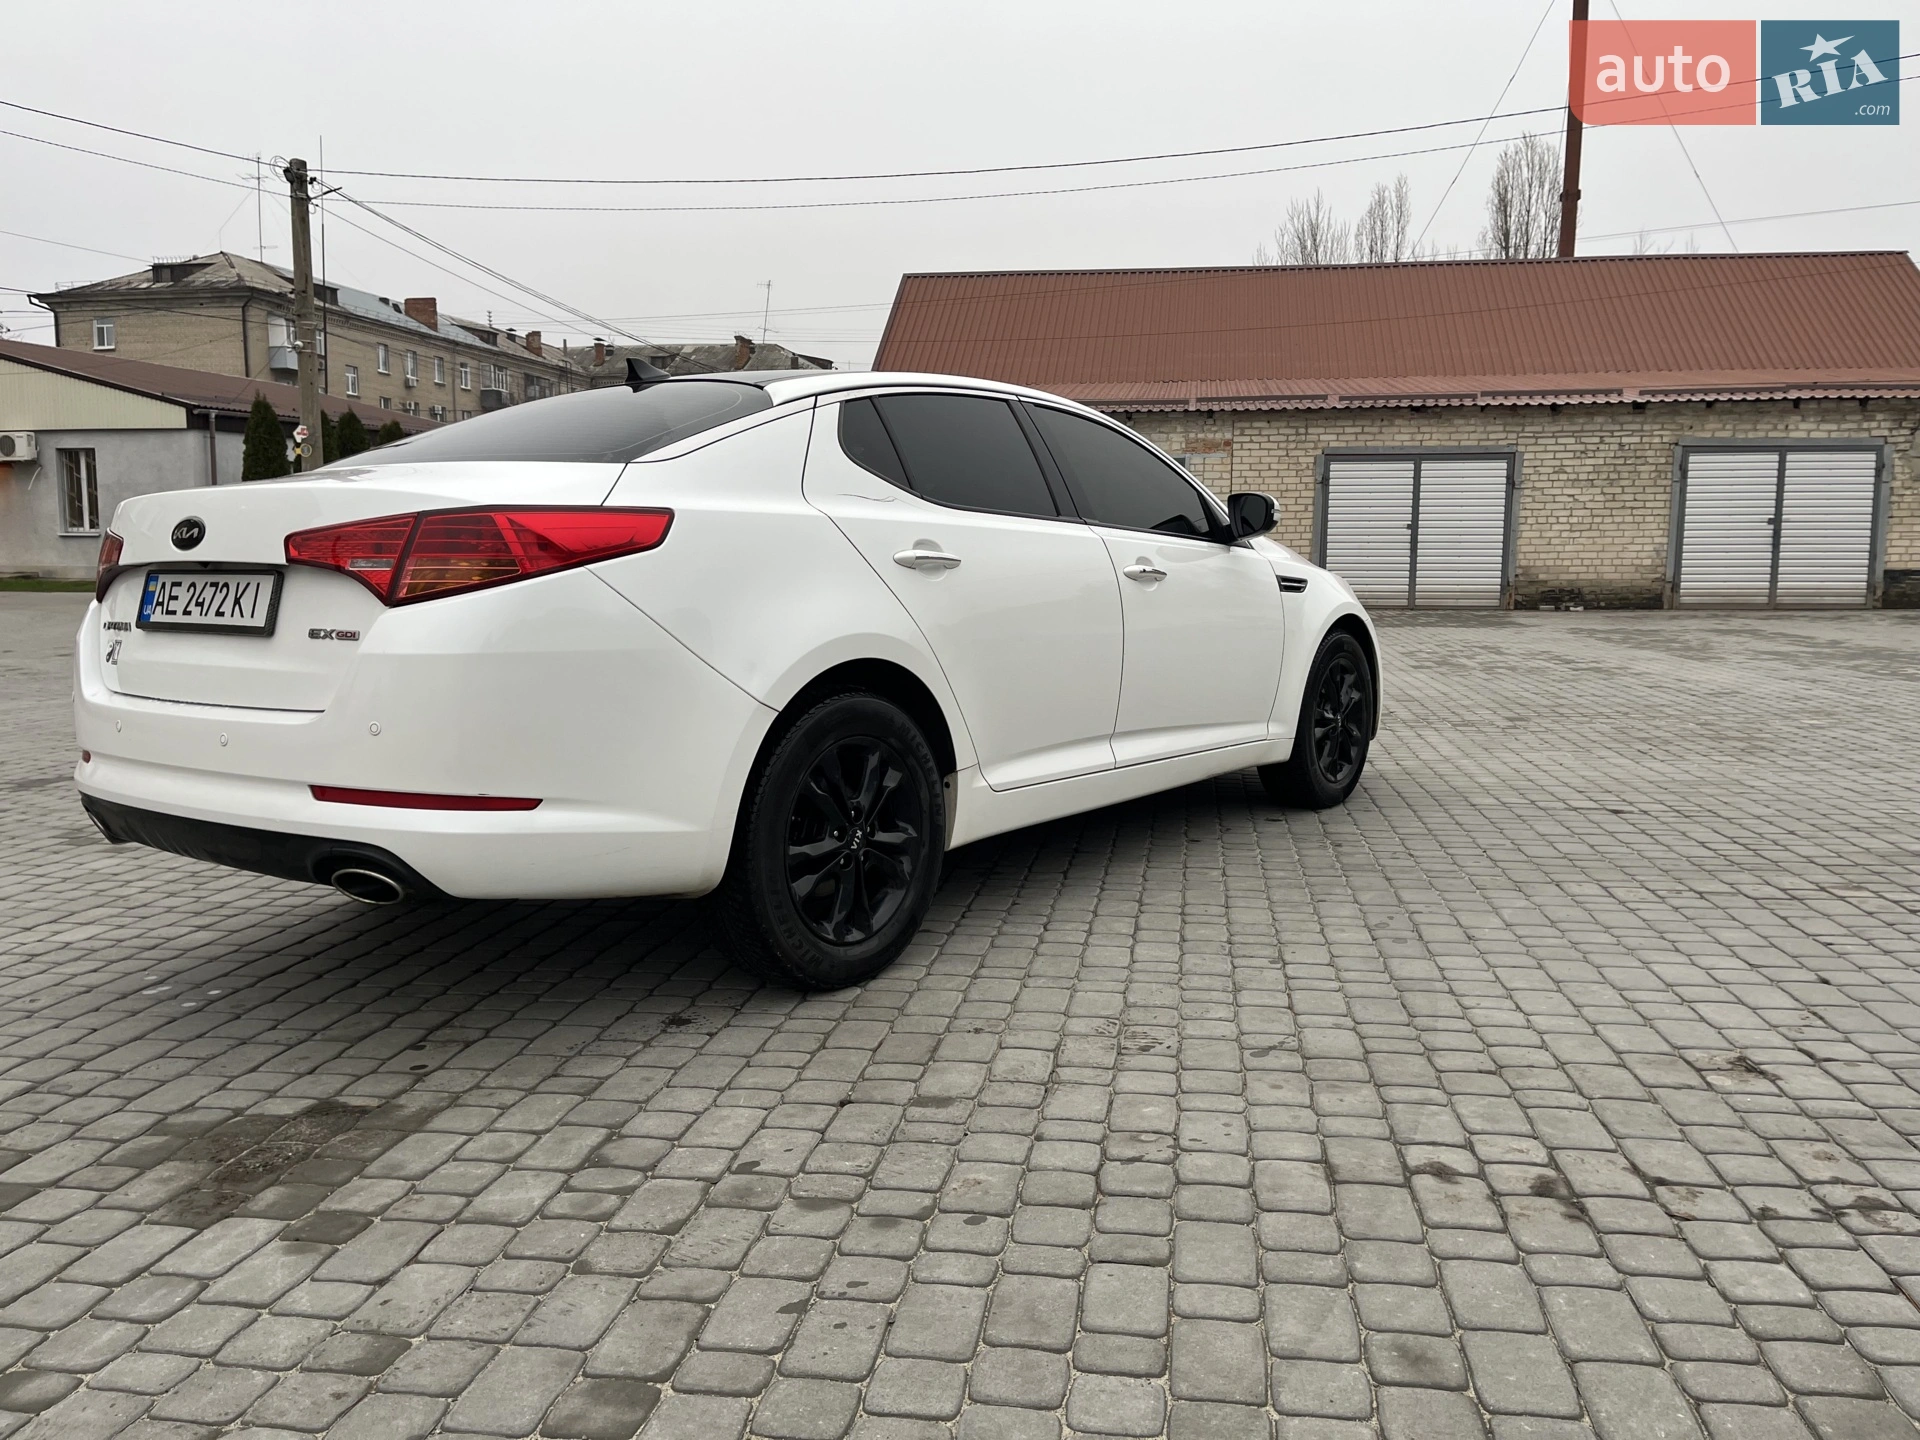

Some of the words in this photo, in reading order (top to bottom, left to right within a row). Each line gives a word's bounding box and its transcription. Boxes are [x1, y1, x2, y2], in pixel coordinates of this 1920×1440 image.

[173, 527, 199, 540] KIA
[152, 581, 183, 616] AE
[182, 581, 231, 617] 2472
[230, 582, 261, 619] KI
[308, 628, 336, 640] EX
[850, 829, 863, 849] KIA
